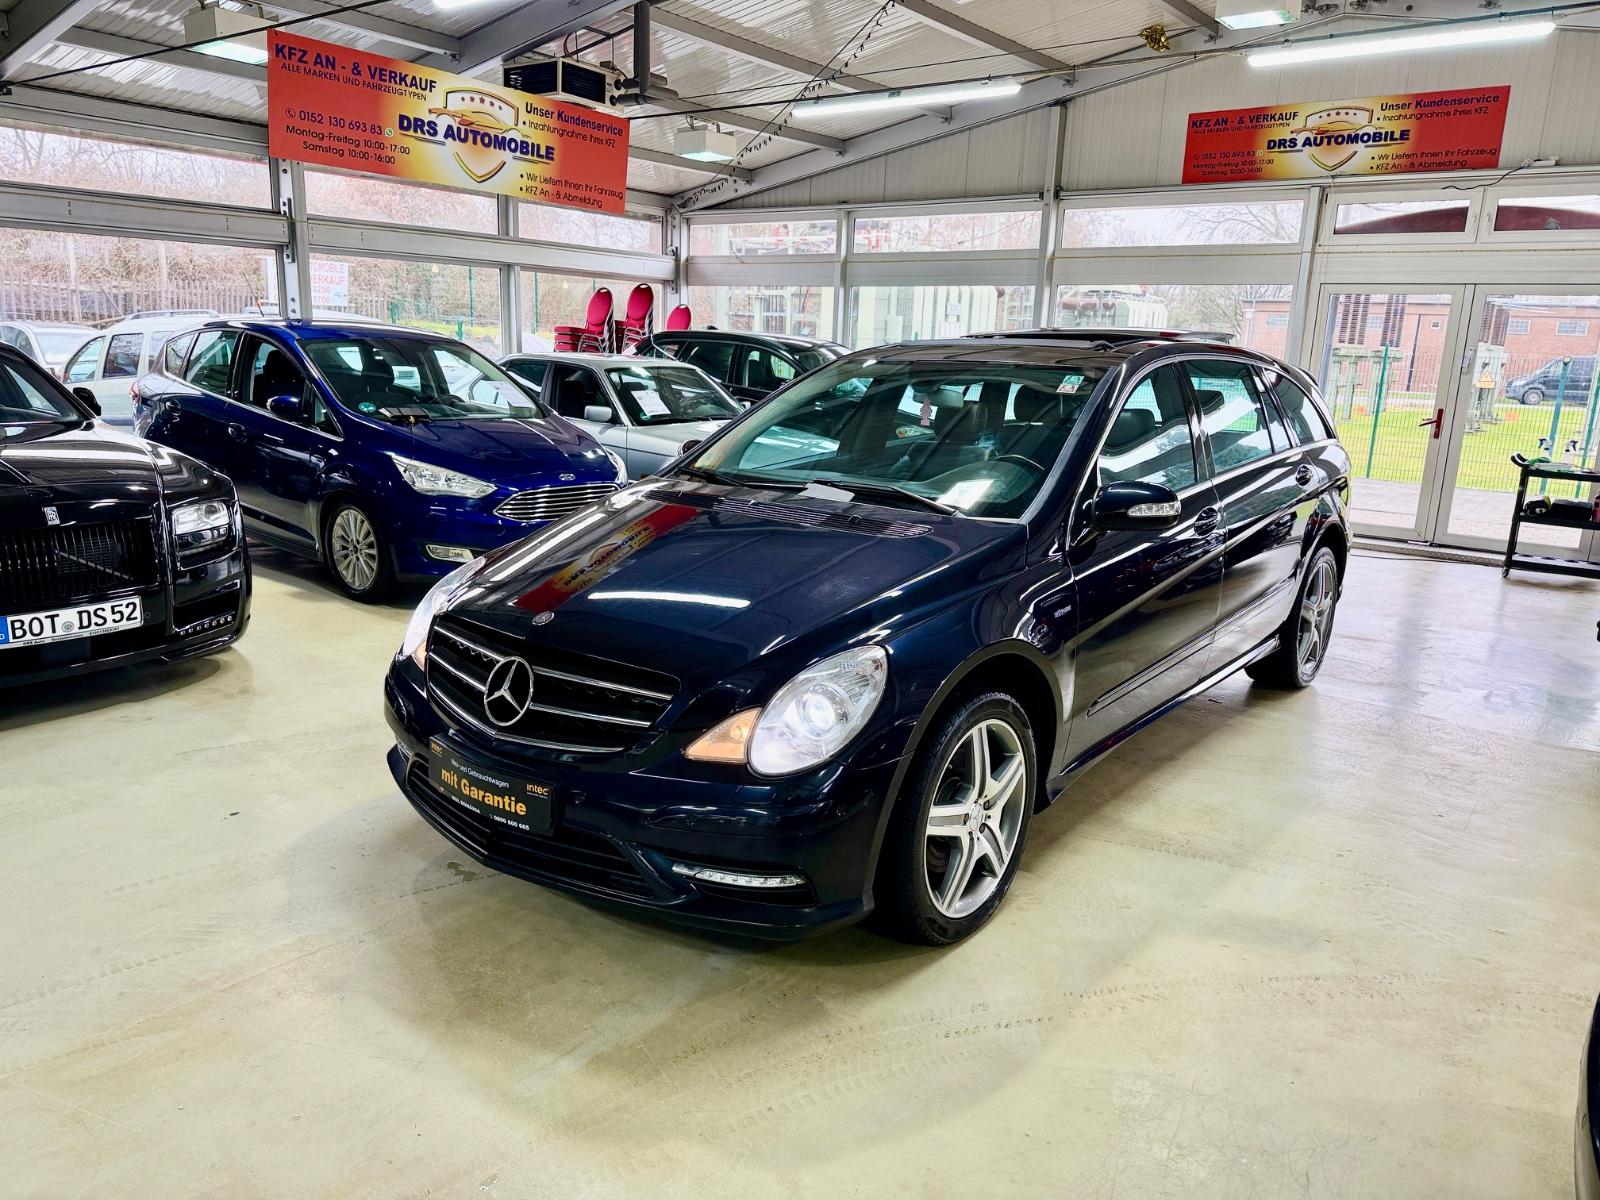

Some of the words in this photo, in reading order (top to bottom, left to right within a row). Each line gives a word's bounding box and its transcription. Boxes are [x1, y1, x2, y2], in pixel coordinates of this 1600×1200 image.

[275, 43, 308, 64] KFZ
[314, 53, 336, 70] AN
[352, 62, 362, 76] &
[368, 65, 437, 93] VERKAUF
[281, 63, 301, 74] ALLE
[304, 67, 340, 82] MARKEN
[343, 76, 361, 87] UND
[363, 80, 427, 101] FAHRZEUGTYPEN
[1381, 102, 1413, 111] Unser
[1415, 95, 1500, 109] Kundenservice
[299, 111, 324, 124] 0152
[328, 116, 345, 128] 130
[349, 121, 367, 133] 693
[370, 124, 382, 135] 83
[526, 102, 555, 119] Unser
[557, 110, 623, 137] Kundenservice
[1192, 120, 1211, 129] KFZ
[1214, 118, 1229, 126] AN
[1238, 116, 1245, 125] &
[1249, 112, 1299, 124] VERKAUF
[1383, 110, 1451, 122] Inzahlungnahme
[286, 125, 360, 148] Montag-Freitag
[364, 139, 410, 155] 10:00-17:00
[399, 114, 438, 137] DRS
[443, 124, 555, 161] AUTOMOBILE
[529, 120, 587, 141] Inzahlungnahme
[590, 135, 603, 145] Ihres
[605, 138, 616, 148] KFZ
[1267, 138, 1298, 150] DRS
[1302, 130, 1410, 147] AUTOMOBILE
[303, 141, 344, 157] Samstag
[348, 149, 395, 165] 10:00-16:00
[1418, 160, 1467, 168] Abmeldung
[1457, 148, 1497, 157] Fahrzeug
[526, 172, 538, 181] Wir
[540, 175, 562, 187] Liefern
[564, 179, 584, 190] Ihnen
[585, 183, 593, 193] Ihr
[595, 185, 623, 200] Fahrzeug
[526, 186, 538, 196] KFZ
[540, 188, 550, 197] An
[556, 191, 561, 200] &
[563, 193, 603, 208] Abmeldung
[312, 275, 345, 286] ERKAUF
[10, 614, 60, 640] BOT
[441, 768, 458, 789] mit
[461, 778, 527, 816] Garantie
[526, 784, 549, 796] intec
